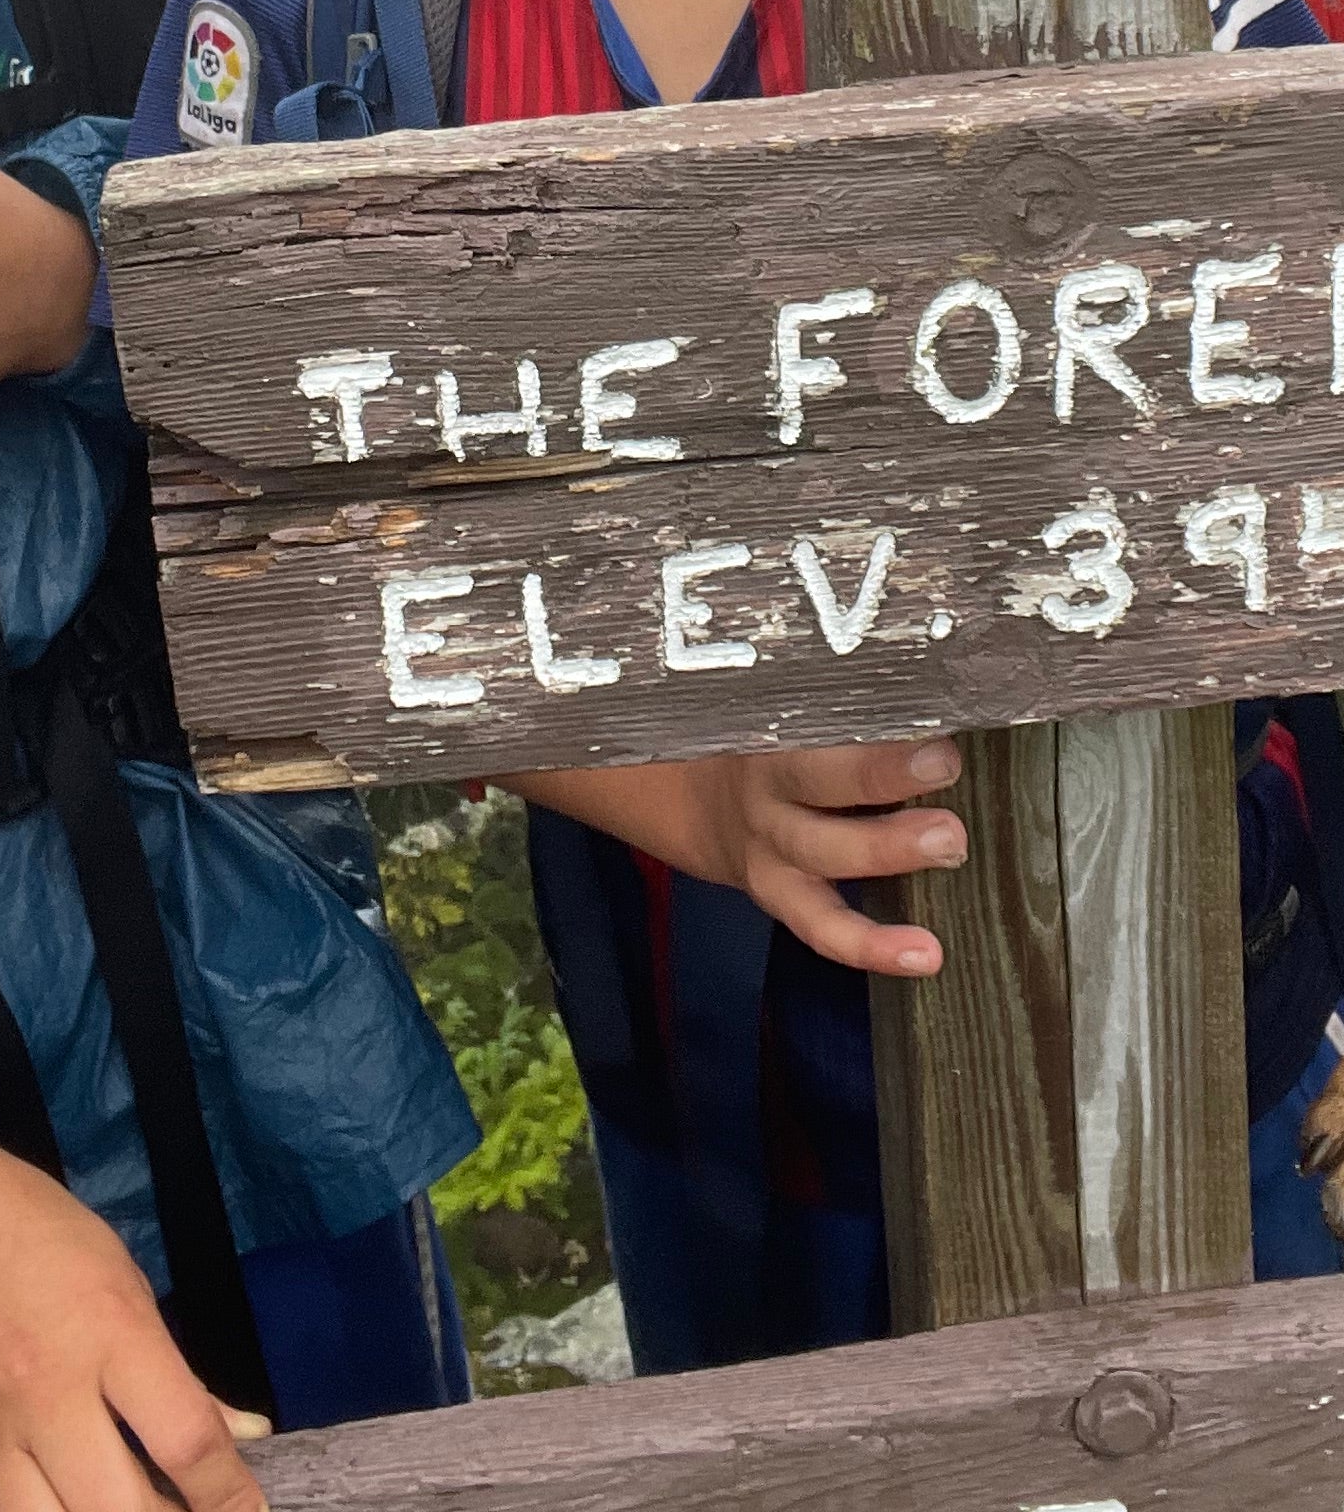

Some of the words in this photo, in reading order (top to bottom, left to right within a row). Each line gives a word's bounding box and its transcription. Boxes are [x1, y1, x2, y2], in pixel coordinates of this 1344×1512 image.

[187, 98, 237, 134] LaLiga
[296, 337, 687, 463] THE
[380, 533, 954, 708] ELEV.
